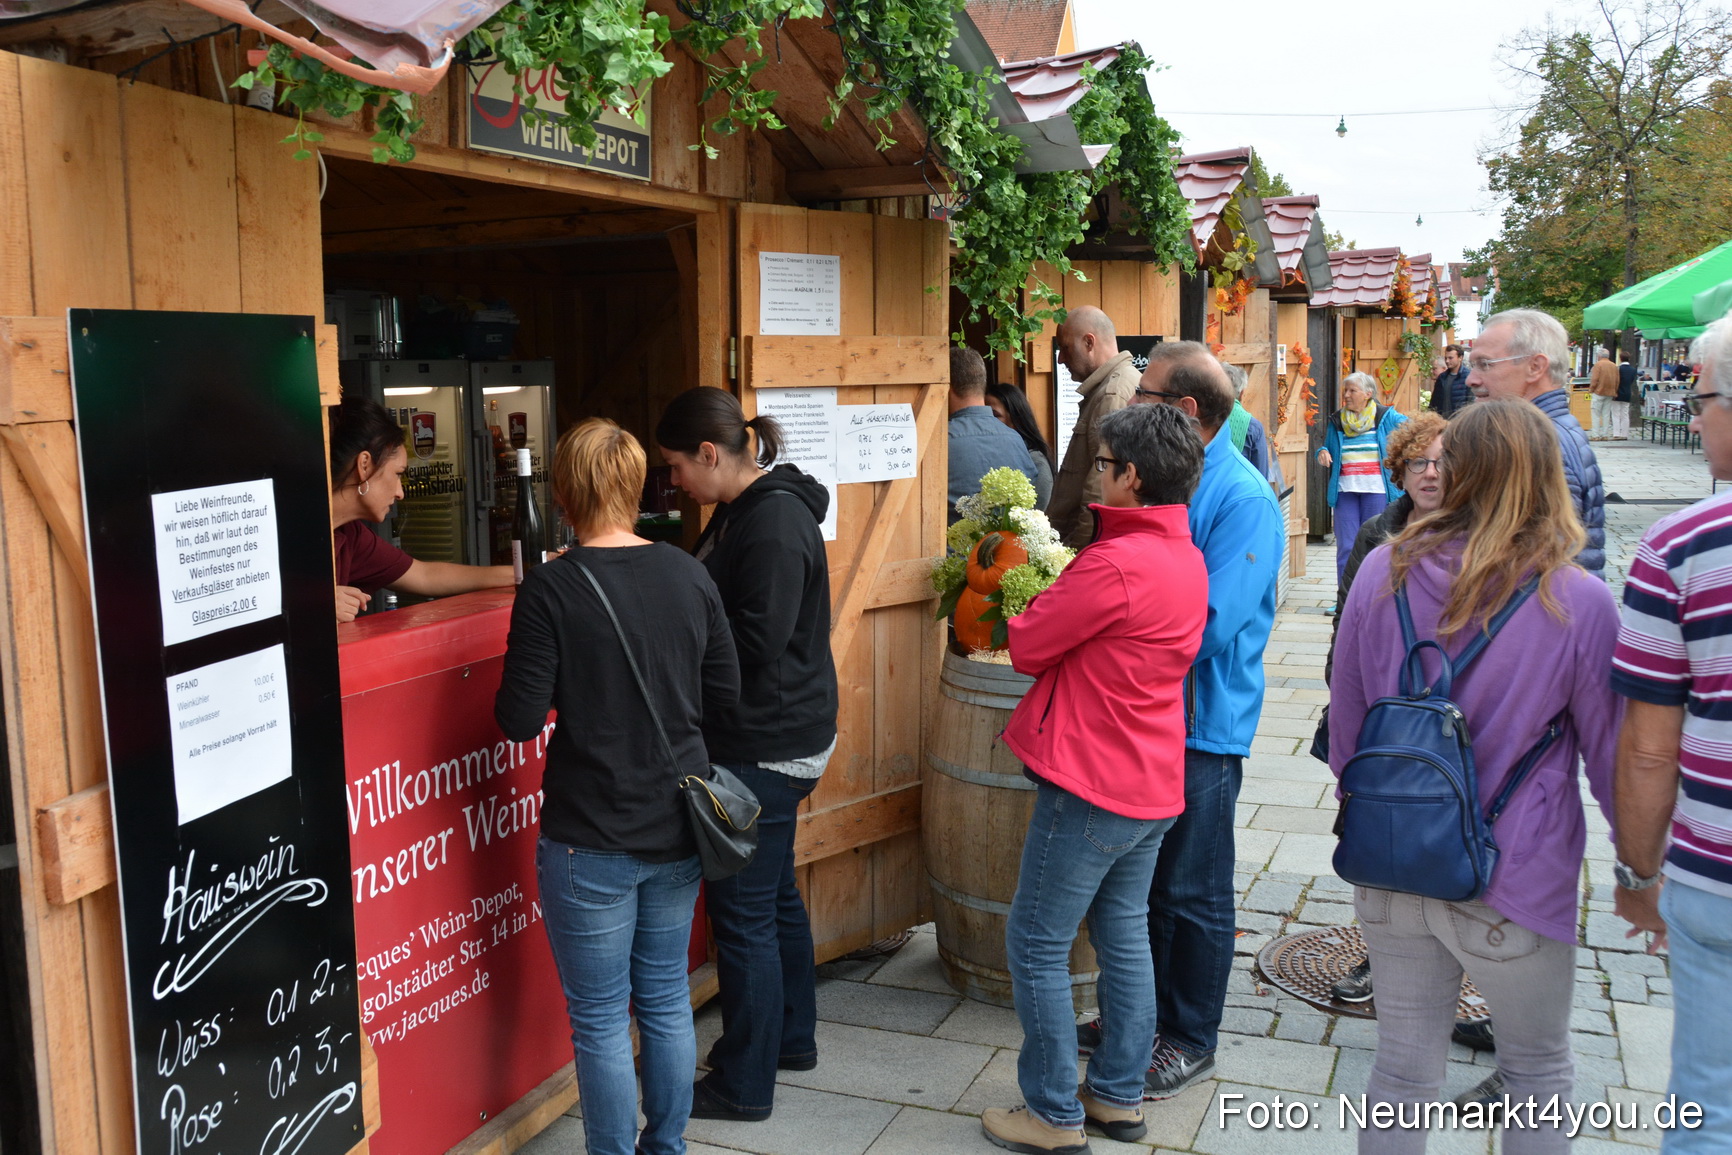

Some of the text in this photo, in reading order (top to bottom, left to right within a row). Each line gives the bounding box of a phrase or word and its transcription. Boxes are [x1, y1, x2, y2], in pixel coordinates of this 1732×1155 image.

[521, 115, 639, 167] WEIN-EPOT
[175, 492, 256, 513] Liebe Weinfreunde,
[164, 505, 268, 532] wir weisen höflich darauf
[175, 524, 259, 548] hin, daß wir laut den
[179, 540, 258, 565] Bestimmungen des
[189, 558, 251, 580] Weinfestes nur
[172, 570, 270, 602] Verkaufsgläser anbieten
[251, 595, 258, 607] €
[176, 672, 275, 693] PFAND 10,00 €
[177, 689, 276, 712] Weinkühler 0,50 €
[179, 710, 221, 731] Mineralwasser
[188, 719, 277, 759] Alle Preise solange Vorrat hält
[353, 827, 454, 903] nserer
[419, 881, 523, 948] Wein-Depot,
[361, 899, 543, 1024] golstädter Str. 14 in N
[267, 979, 299, 1026] 0,1
[268, 1044, 301, 1099] 0,2
